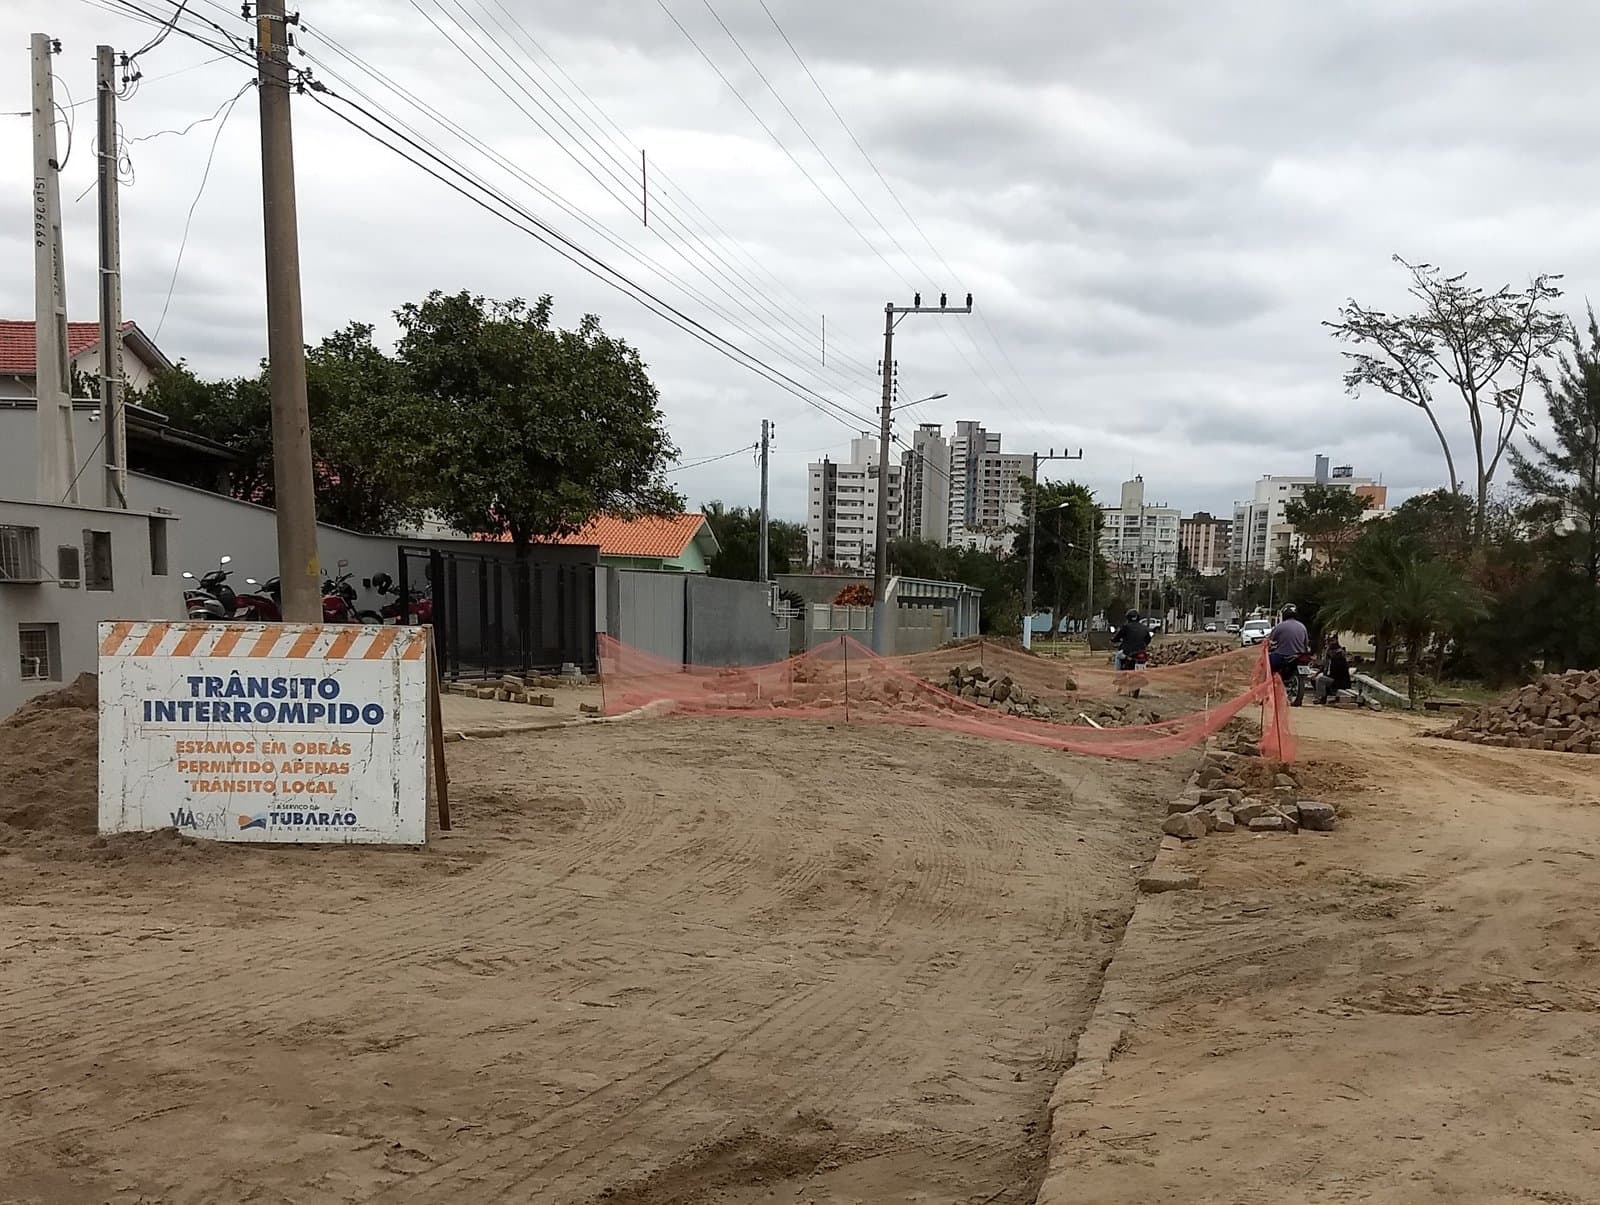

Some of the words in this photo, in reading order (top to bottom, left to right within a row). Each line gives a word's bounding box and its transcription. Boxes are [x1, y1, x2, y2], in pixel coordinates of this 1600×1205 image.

[187, 670, 340, 699] TRÂNSITO
[144, 701, 384, 725] INTERROMPIDO
[176, 740, 255, 754] ESTAMOS
[261, 742, 286, 754] EM
[293, 742, 352, 756] OBRAS
[178, 760, 274, 774] PERMITIDO
[280, 761, 350, 774] APENAS
[190, 776, 276, 793] TRÂNSITO
[282, 780, 337, 794] LOCAL
[270, 810, 356, 826] TUBARÃO
